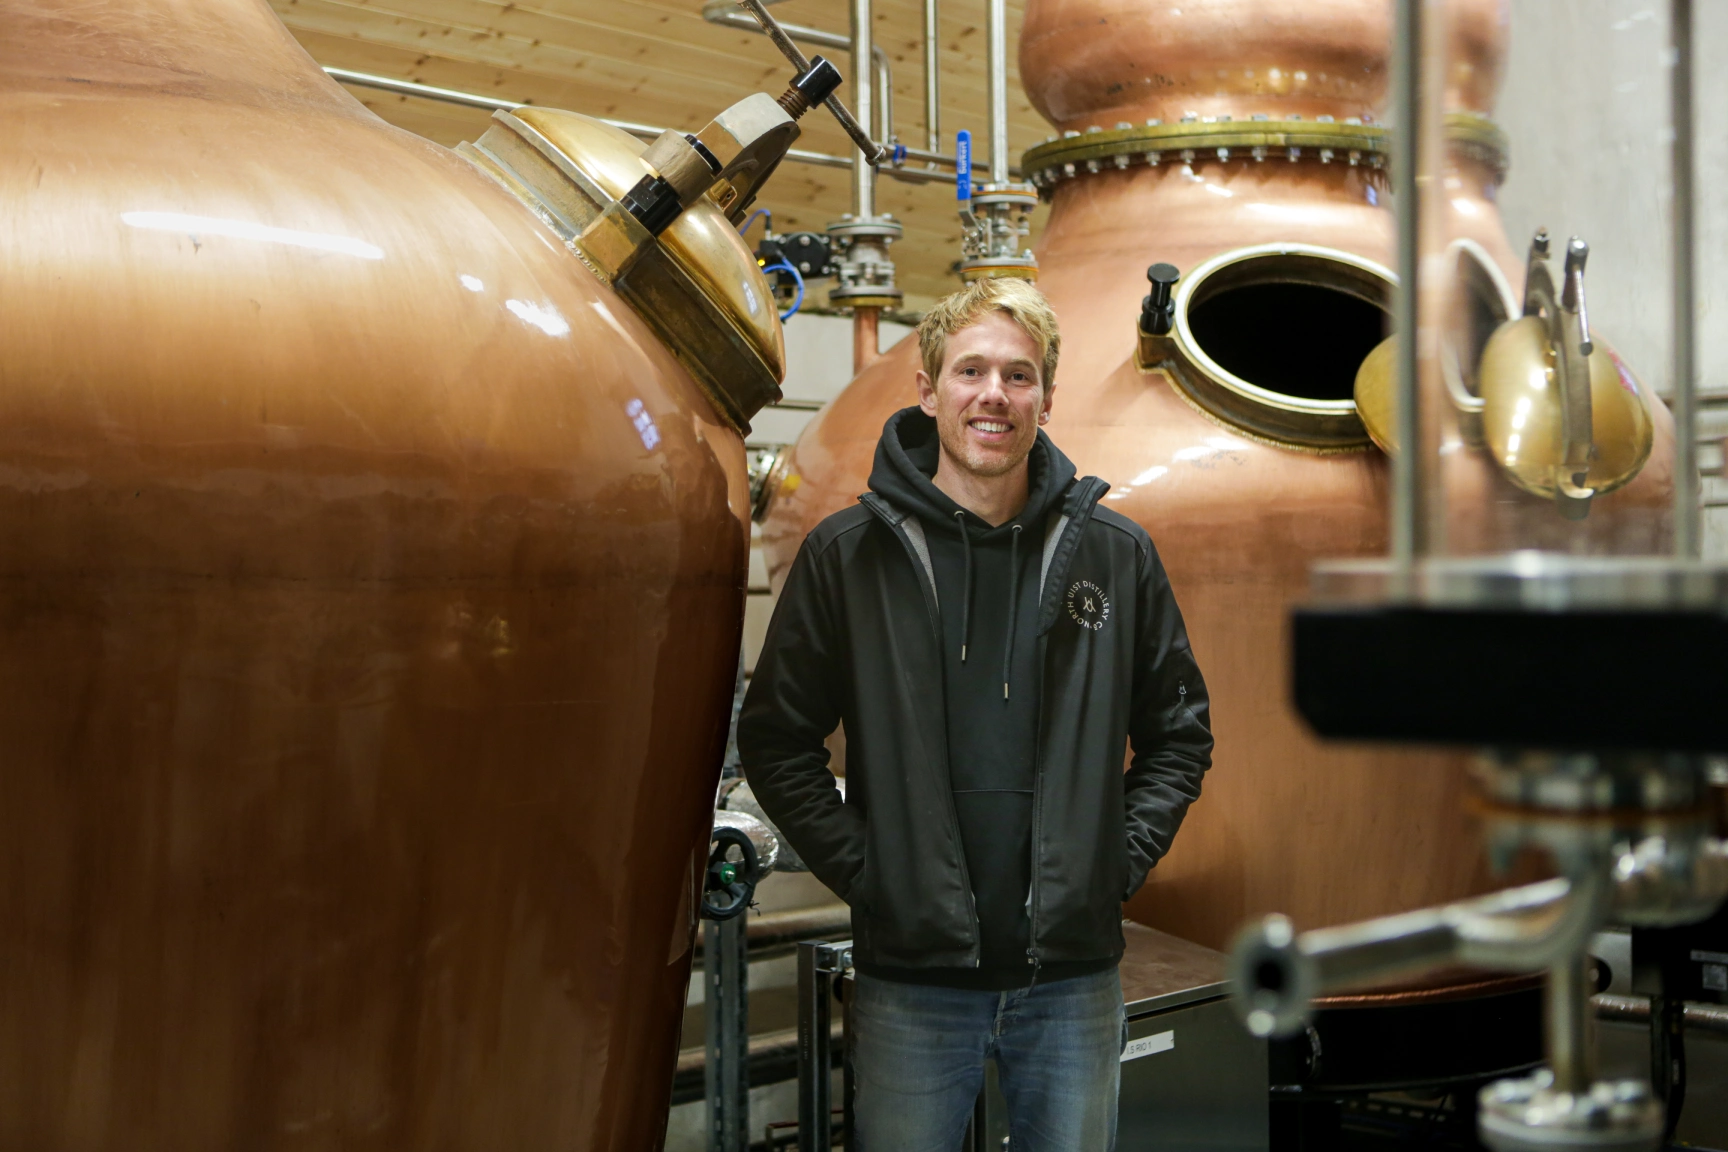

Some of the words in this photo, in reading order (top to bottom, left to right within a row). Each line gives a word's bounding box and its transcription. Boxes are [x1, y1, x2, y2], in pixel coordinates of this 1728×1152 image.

[1067, 581, 1081, 598] UIST
[1082, 580, 1110, 621] DISTILLERY
[1067, 601, 1090, 629] NORTH
